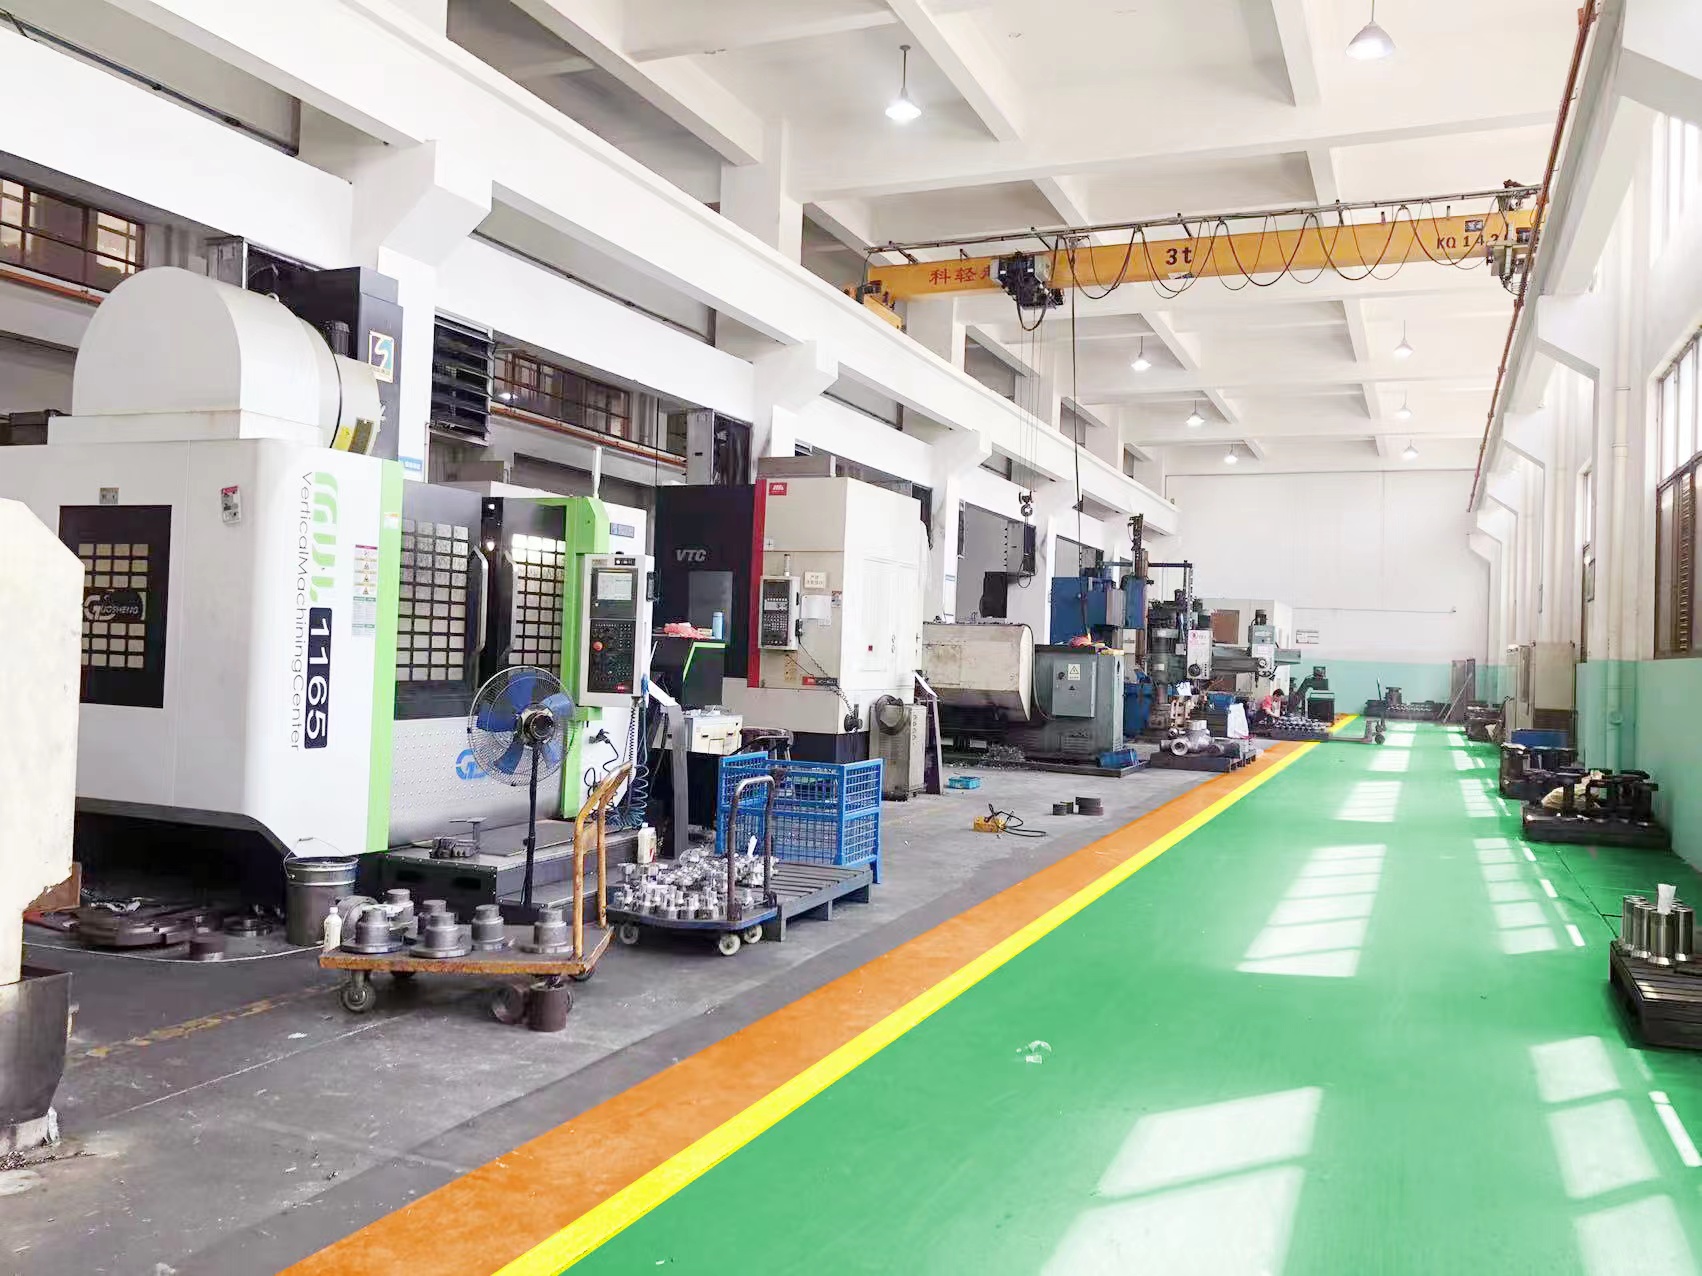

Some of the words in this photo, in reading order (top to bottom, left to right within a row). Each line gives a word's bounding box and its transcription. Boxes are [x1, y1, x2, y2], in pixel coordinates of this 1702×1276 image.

[1165, 247, 1192, 265] 3t
[675, 549, 707, 562] VTC
[306, 617, 330, 740] 1165
